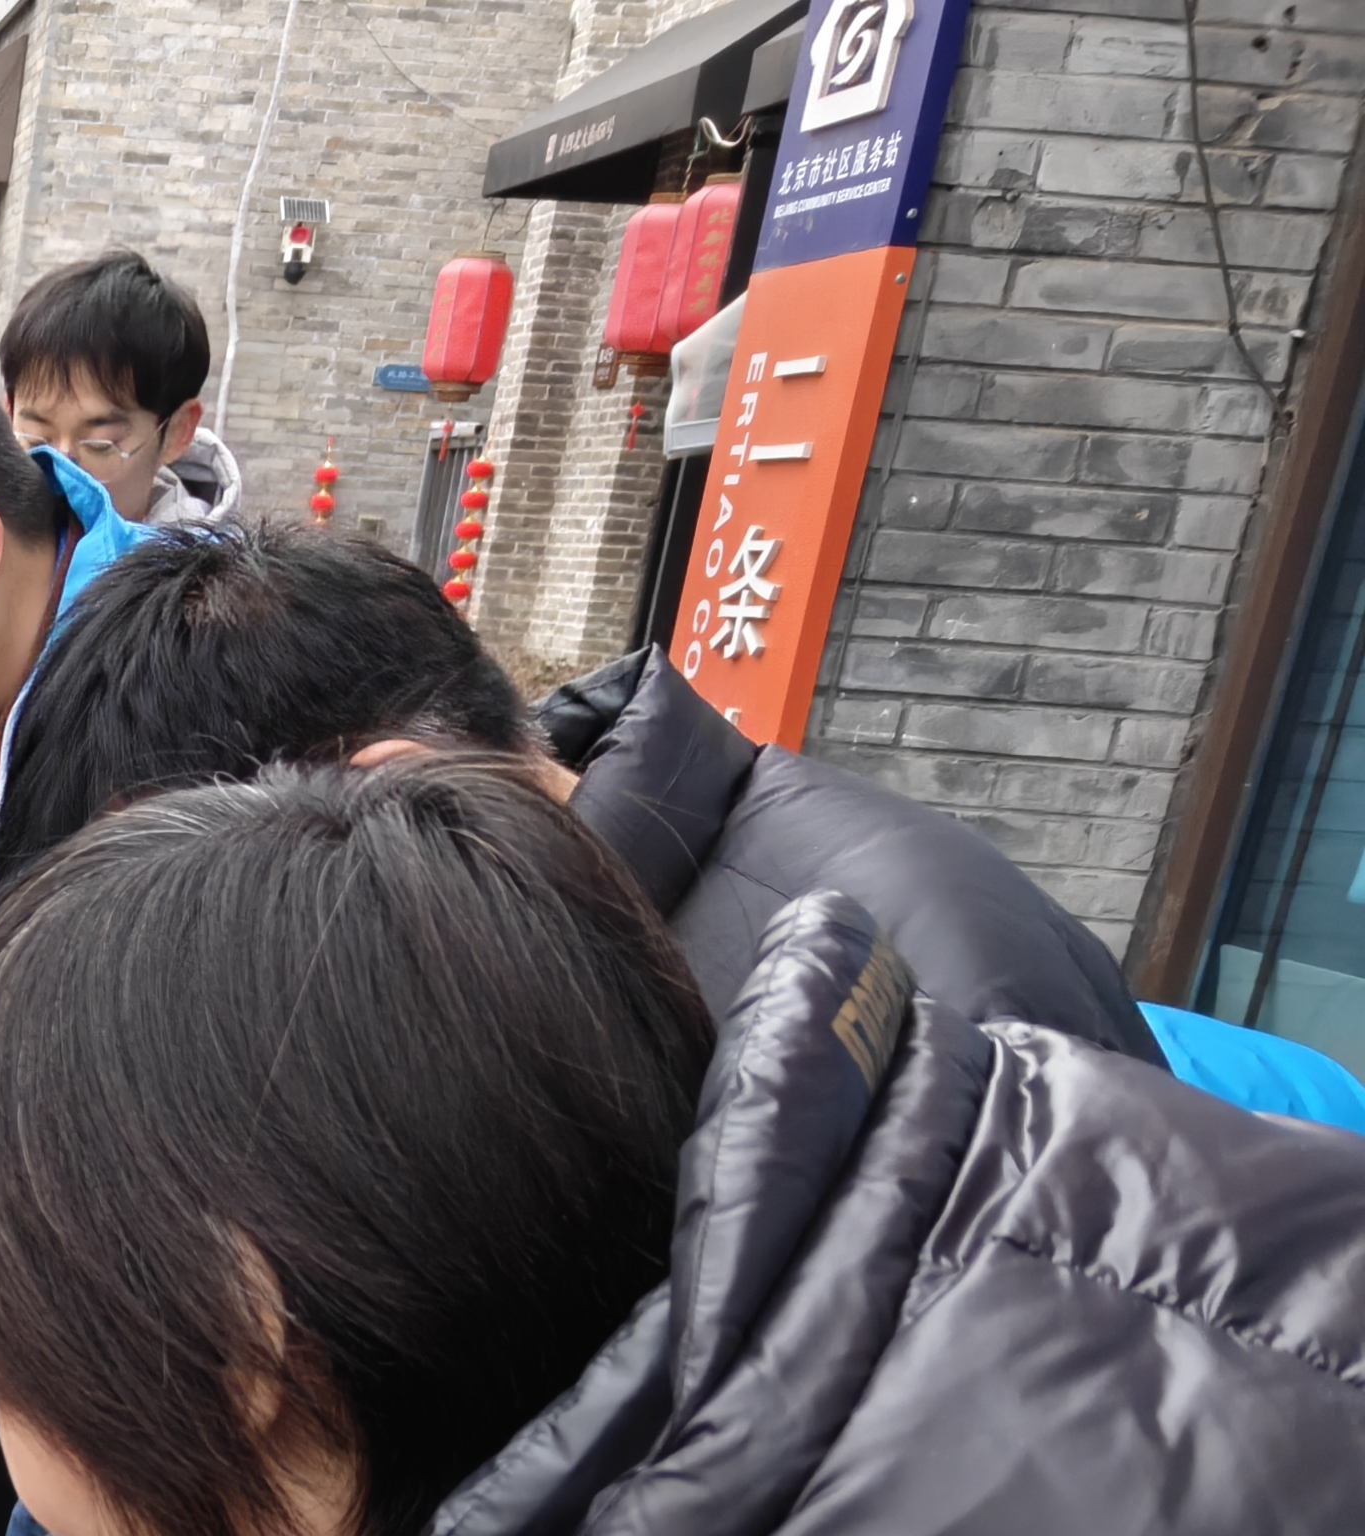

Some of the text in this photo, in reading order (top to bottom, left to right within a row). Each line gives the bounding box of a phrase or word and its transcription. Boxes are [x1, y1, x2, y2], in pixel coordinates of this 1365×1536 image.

[777, 130, 902, 197] 北京市社区服务站
[837, 184, 865, 205] SERVICE
[864, 176, 892, 199] CENTER
[683, 352, 768, 680] ERTIAO CO
[710, 354, 827, 726] 二条
